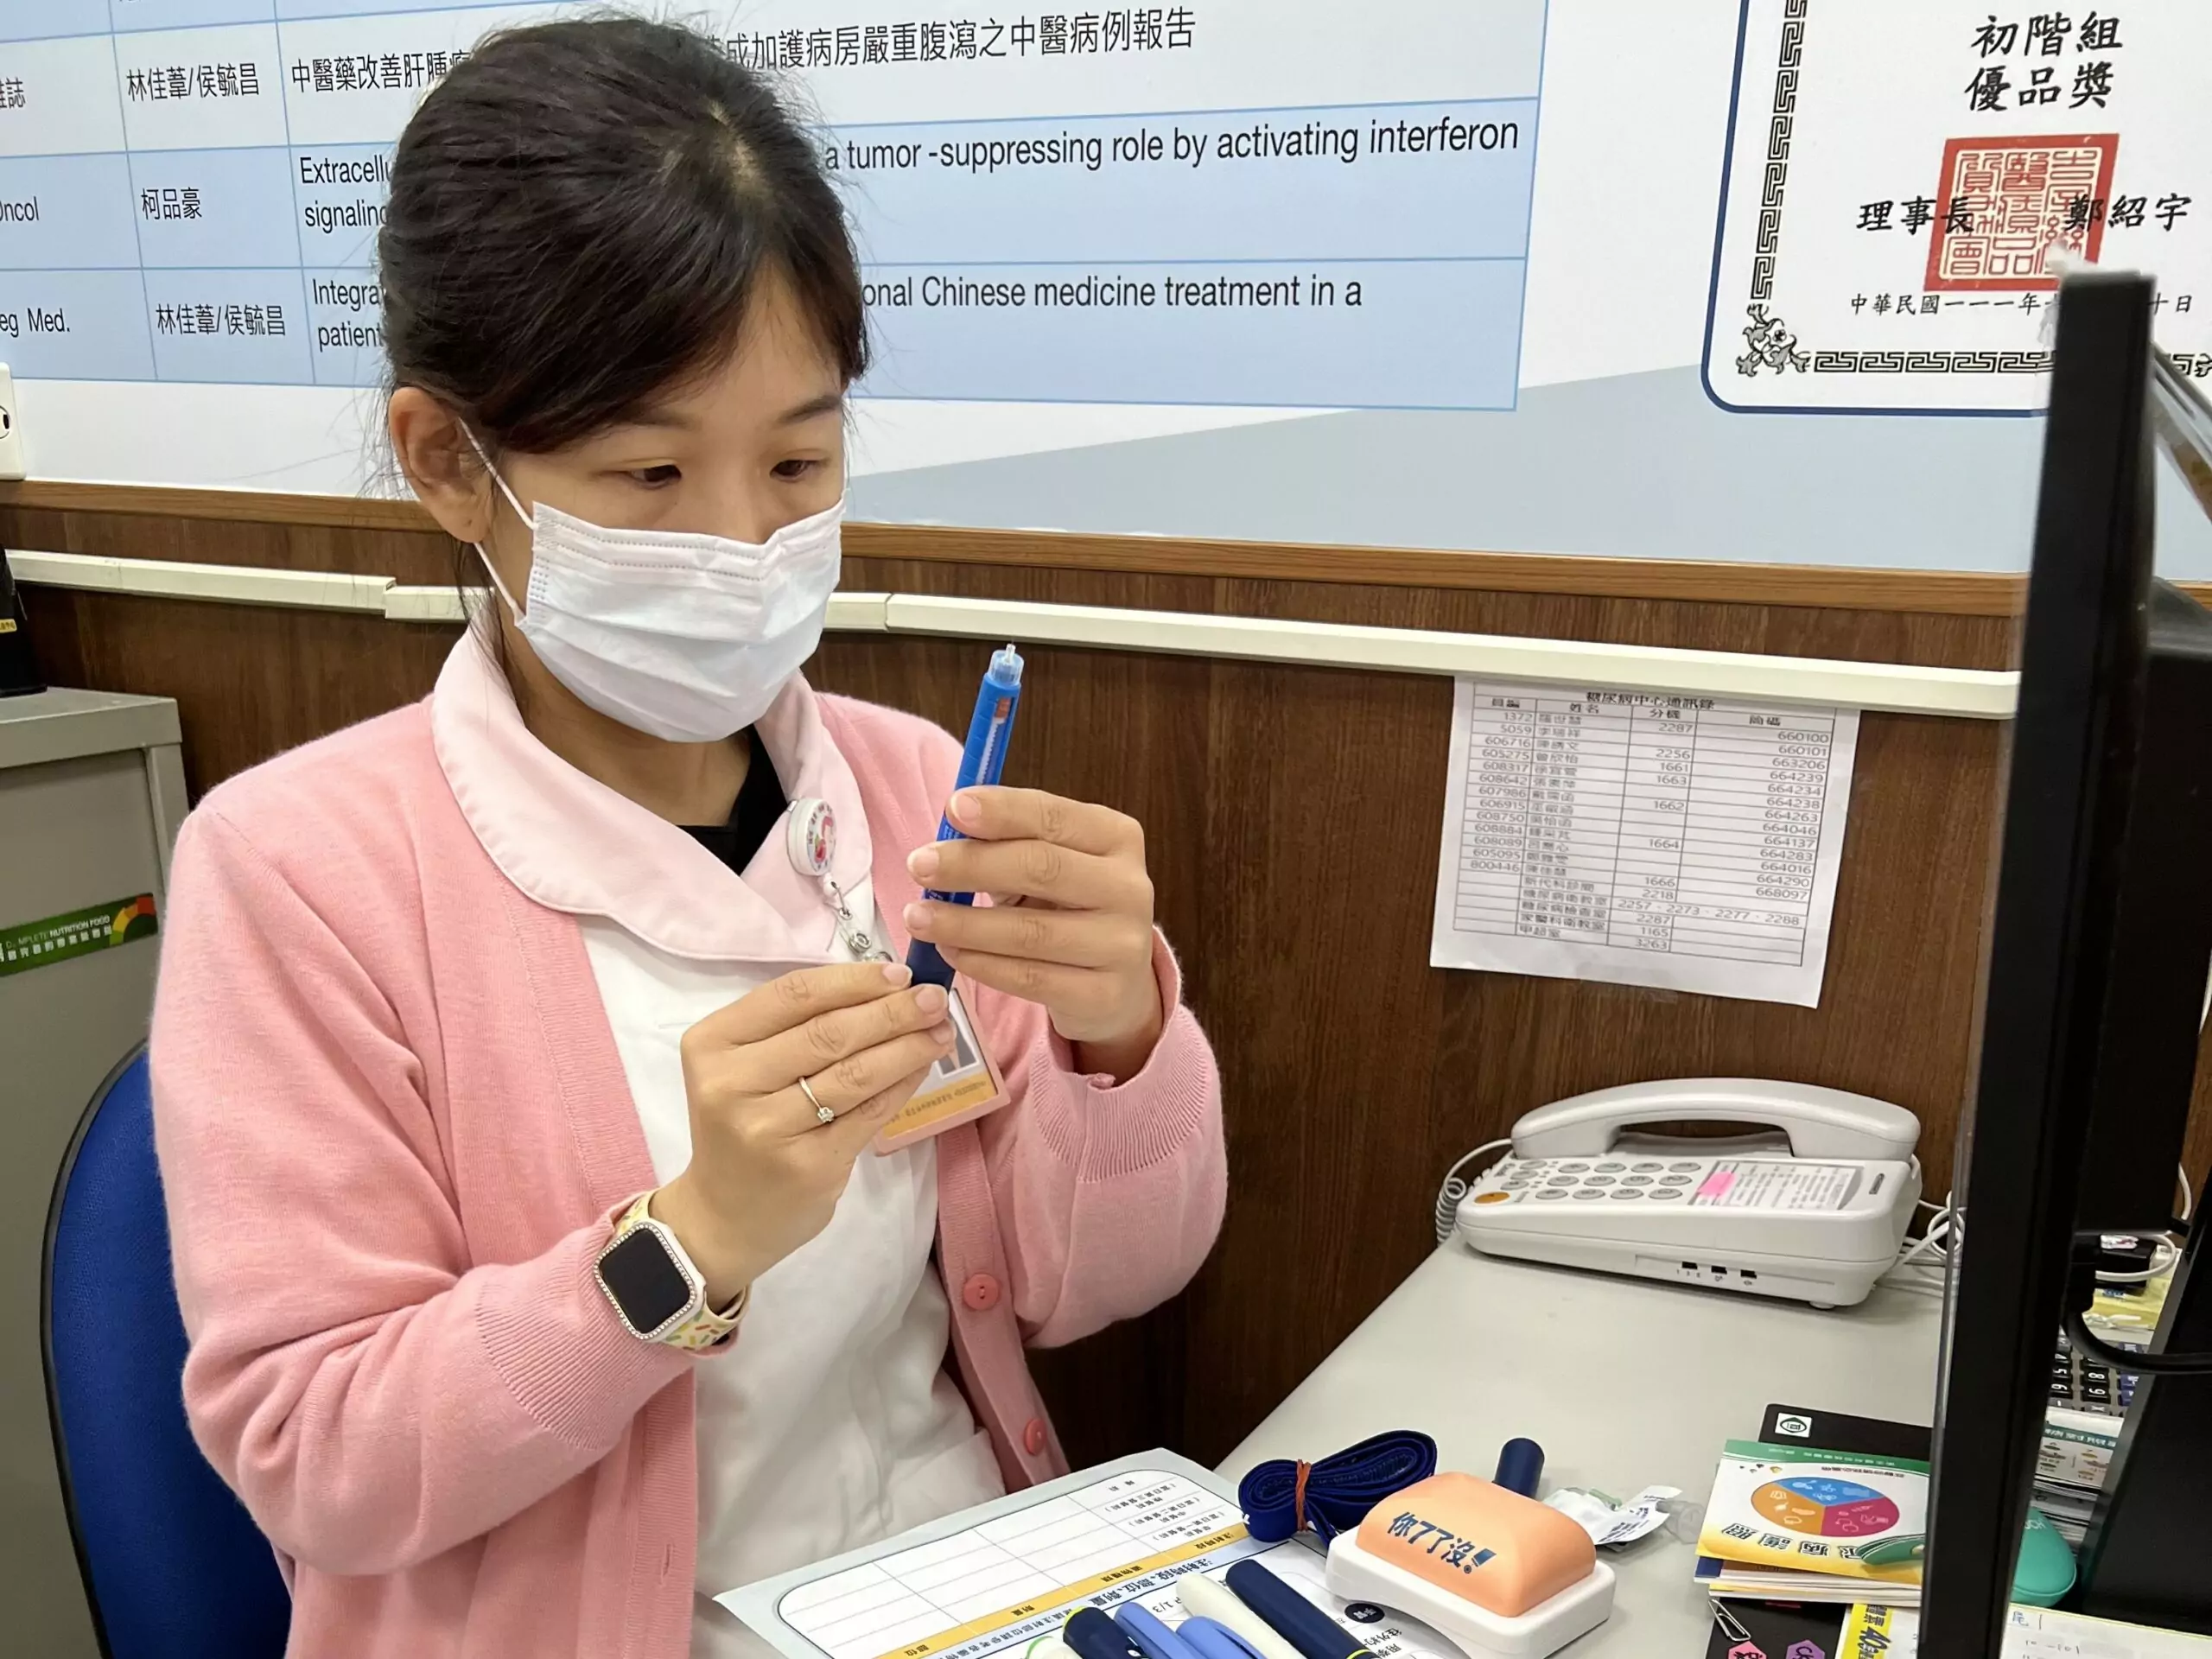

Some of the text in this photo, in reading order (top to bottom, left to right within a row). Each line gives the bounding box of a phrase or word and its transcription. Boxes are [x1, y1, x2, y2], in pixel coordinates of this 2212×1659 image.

[707, 6, 1196, 71] 成加護病房嚴重腹瀉之中醫病例報告
[1970, 11, 2124, 58] 初階組
[126, 63, 260, 102] 林佳葦/侯毓昌
[1965, 61, 2113, 111] 優品獎
[826, 147, 840, 169] a
[848, 141, 921, 169] tumor
[928, 130, 1102, 173] -suppressing
[1113, 129, 1163, 161] role
[1173, 127, 1207, 168] by
[1217, 122, 1358, 163] activating
[1370, 116, 1518, 154] interferon
[141, 187, 202, 220] 柯品豪
[1855, 193, 2191, 234] 理事長 鄭紹宇
[313, 278, 385, 312] Integra
[922, 276, 1026, 308] Chinese
[1035, 276, 1156, 308] medicine
[1165, 276, 1300, 307] treatment
[1311, 274, 1334, 307] in
[1345, 280, 1363, 307] a
[28, 308, 70, 333] Med.
